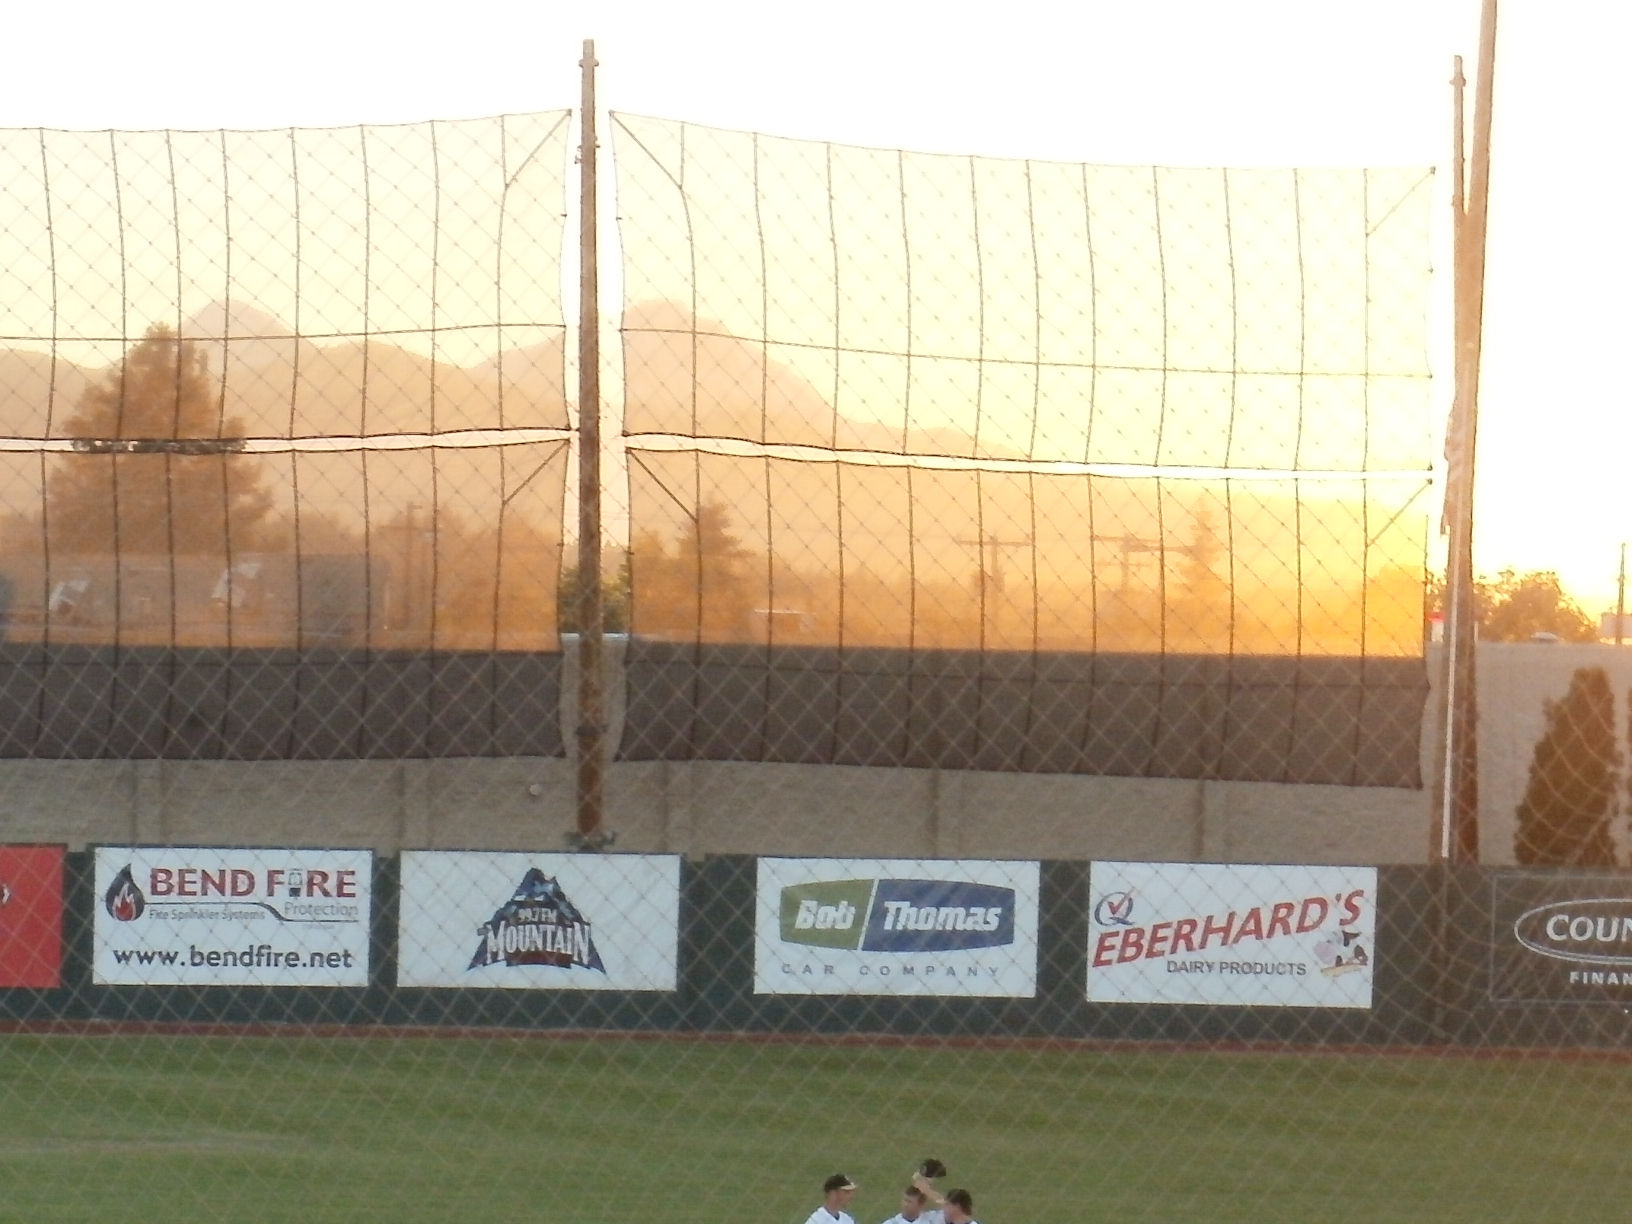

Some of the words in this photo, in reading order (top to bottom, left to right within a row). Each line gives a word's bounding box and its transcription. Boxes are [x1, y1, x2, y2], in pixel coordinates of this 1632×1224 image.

[149, 867, 256, 898] BEND
[171, 908, 219, 921] Sprinkler
[222, 909, 266, 921] Systems
[283, 901, 359, 918] Protection
[794, 899, 857, 931] Bob
[882, 900, 1003, 932] Thomas
[1091, 889, 1365, 969] EBERHARD'S
[486, 920, 590, 964] MOUNTAIN
[113, 944, 353, 968] www.bendfire.net
[1167, 960, 1215, 974] DAIRY
[1219, 960, 1307, 976] PRODUCTS
[781, 963, 836, 975] CAR
[859, 964, 1000, 977] COMPANY
